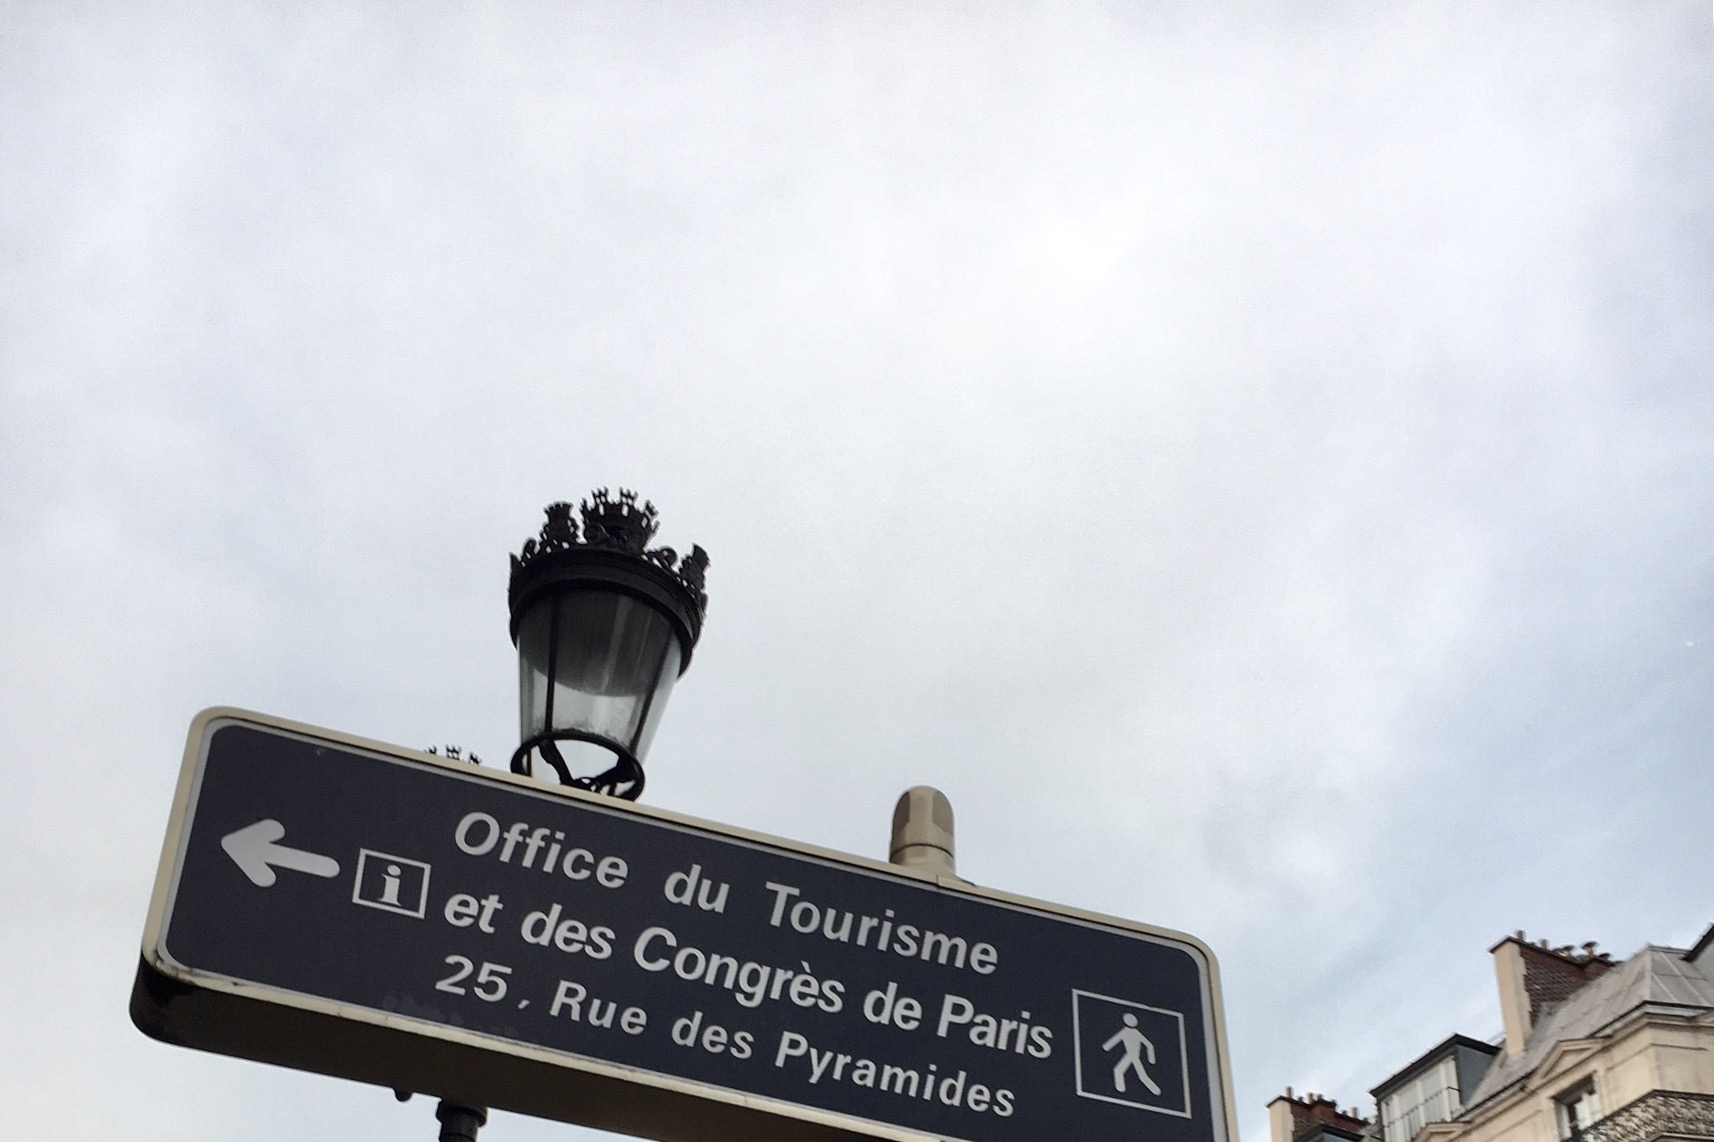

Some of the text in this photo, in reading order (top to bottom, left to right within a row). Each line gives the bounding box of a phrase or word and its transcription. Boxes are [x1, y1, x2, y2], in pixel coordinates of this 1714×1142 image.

[455, 812, 998, 975] Office du Tourisme
[444, 893, 1053, 1059] et des Congrès de Paris
[549, 979, 647, 1035] Rue
[671, 1010, 754, 1059] des
[775, 1030, 1015, 1117] Pyramides
